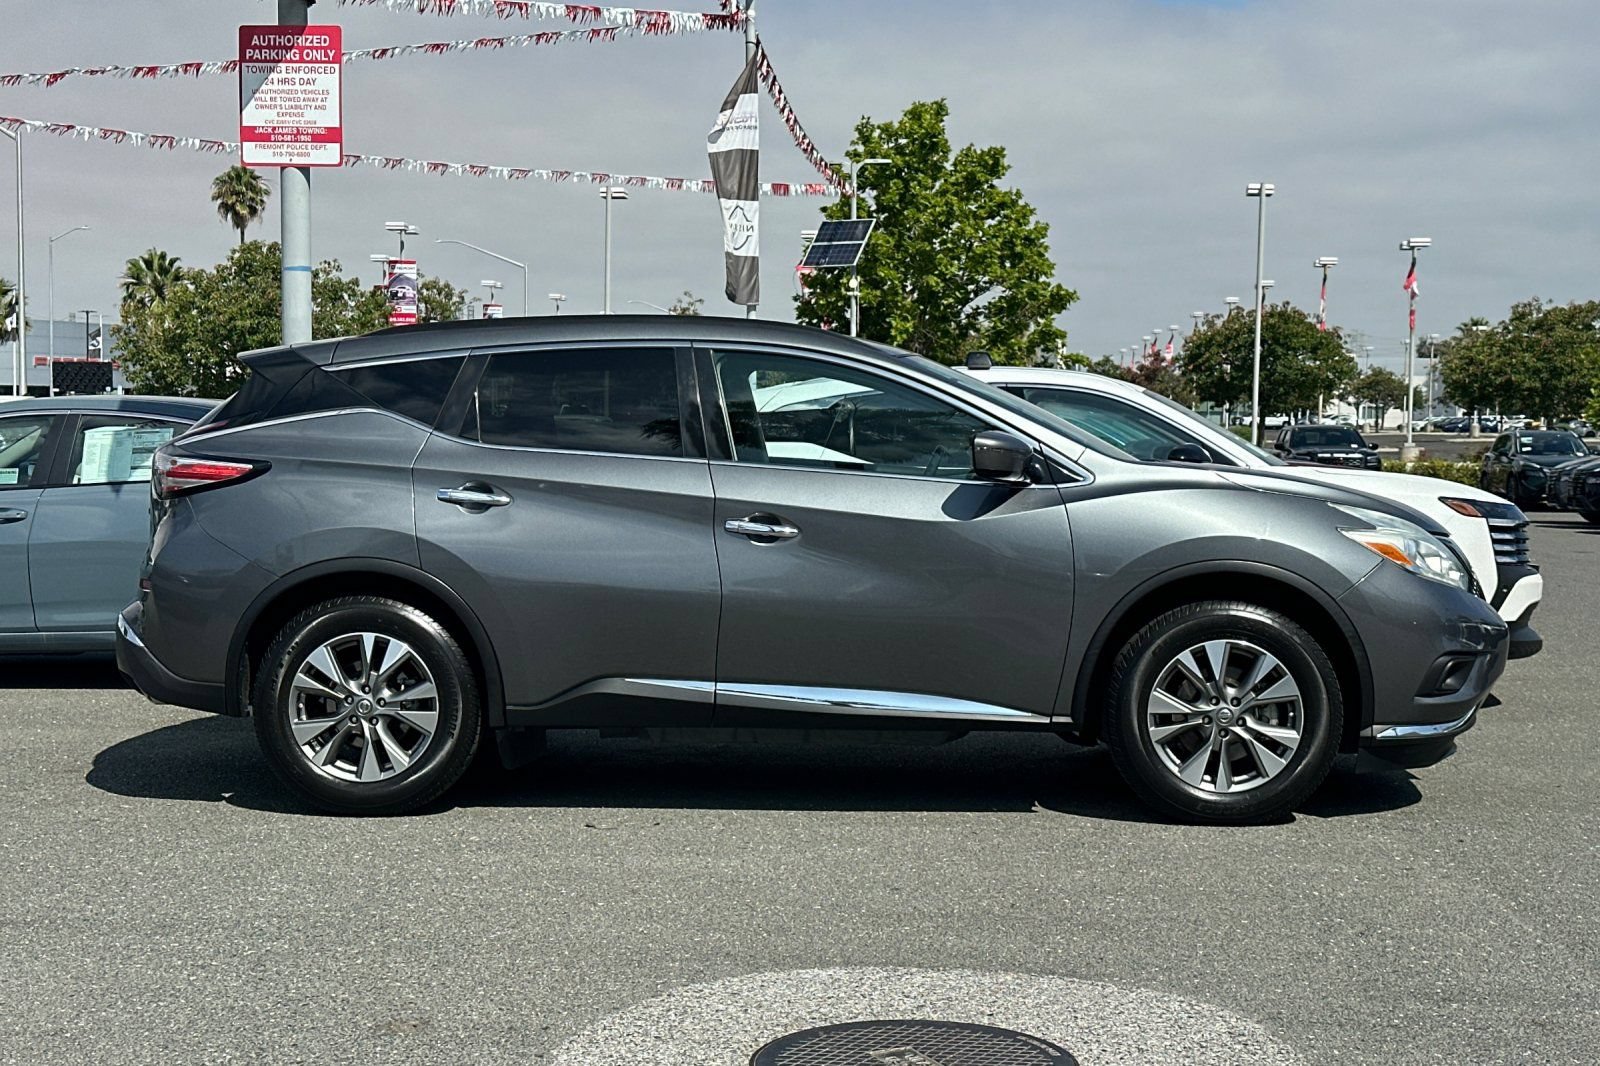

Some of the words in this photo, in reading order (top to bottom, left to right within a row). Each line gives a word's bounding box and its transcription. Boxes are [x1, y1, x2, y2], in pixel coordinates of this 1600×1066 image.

[251, 34, 330, 47] AUTHORIZED
[245, 49, 300, 61] PARKING
[303, 49, 336, 61] ONLY
[245, 65, 283, 75] TOWING
[285, 65, 336, 75] ENFORCED
[264, 77, 275, 86] 24
[277, 77, 296, 86] HRS
[298, 77, 317, 86] DAY
[251, 88, 299, 96] UNAUTHORIZED
[298, 127, 328, 135] TOWING:
